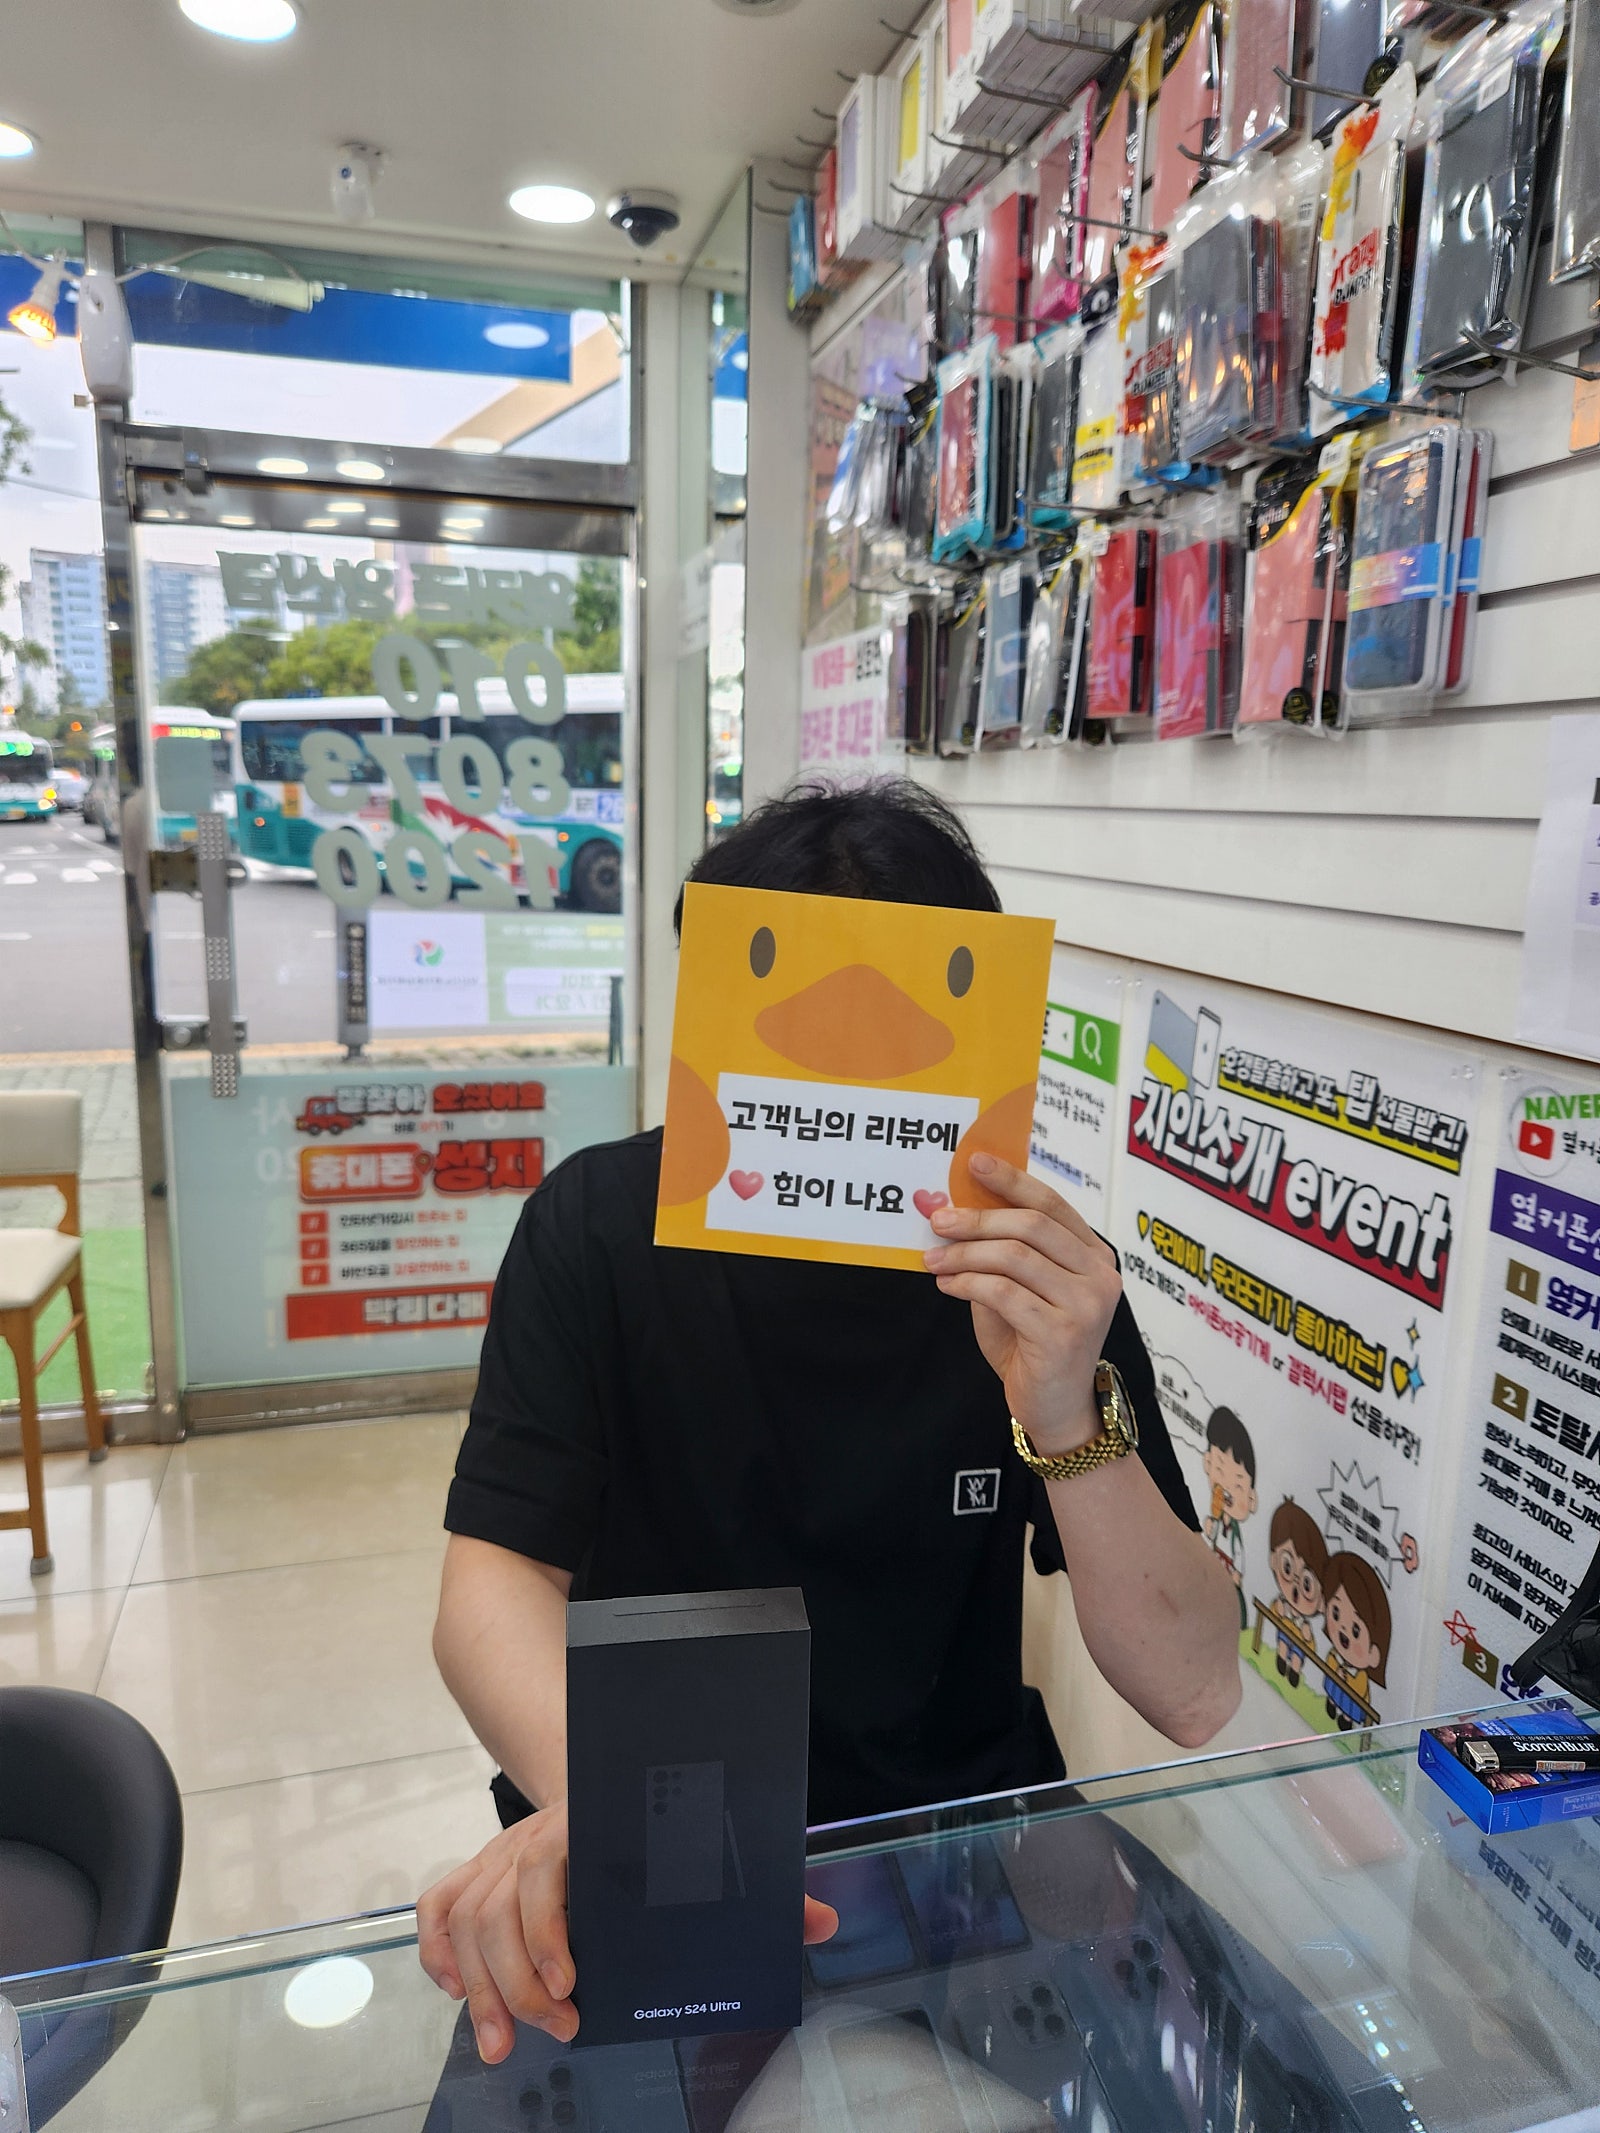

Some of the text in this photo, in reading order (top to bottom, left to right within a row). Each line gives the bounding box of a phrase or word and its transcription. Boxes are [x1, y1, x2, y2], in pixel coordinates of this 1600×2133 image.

[728, 1100, 960, 1153] 고객님의 리뷰에
[1222, 1047, 1316, 1101] 호갱탈출하고
[1343, 1071, 1379, 1128] 탭
[1376, 1095, 1467, 1155] 선물받고!
[773, 1170, 905, 1214] 힘이 나요
[1133, 1077, 1452, 1283] 지인소개 event
[1293, 1301, 1389, 1393] 좋아하는!
[1540, 1326, 1584, 1361] 새로운
[1272, 1356, 1284, 1371] or
[1287, 1353, 1350, 1416] 갤럭시탭
[1503, 1385, 1519, 1409] 2
[1482, 1446, 1522, 1482] 휴대폰
[1523, 1469, 1552, 1500] 구매
[1551, 1487, 1566, 1508] 후
[1484, 1420, 1512, 1449] 항상
[1512, 1436, 1569, 1483] 노력하고,
[1478, 1472, 1575, 1544] 가능한 것이지요.
[1468, 1572, 1483, 1593] 이
[1470, 1547, 1523, 1593] 옆커폰을
[1472, 1521, 1514, 1560] 최고의
[1513, 1548, 1567, 1596] 서비스와
[1474, 1652, 1488, 1674] 3
[1478, 1839, 1532, 1904] 복잡한
[1534, 1895, 1574, 1948] 구매
[634, 2001, 741, 2020] Galaxy S24 Ultra
